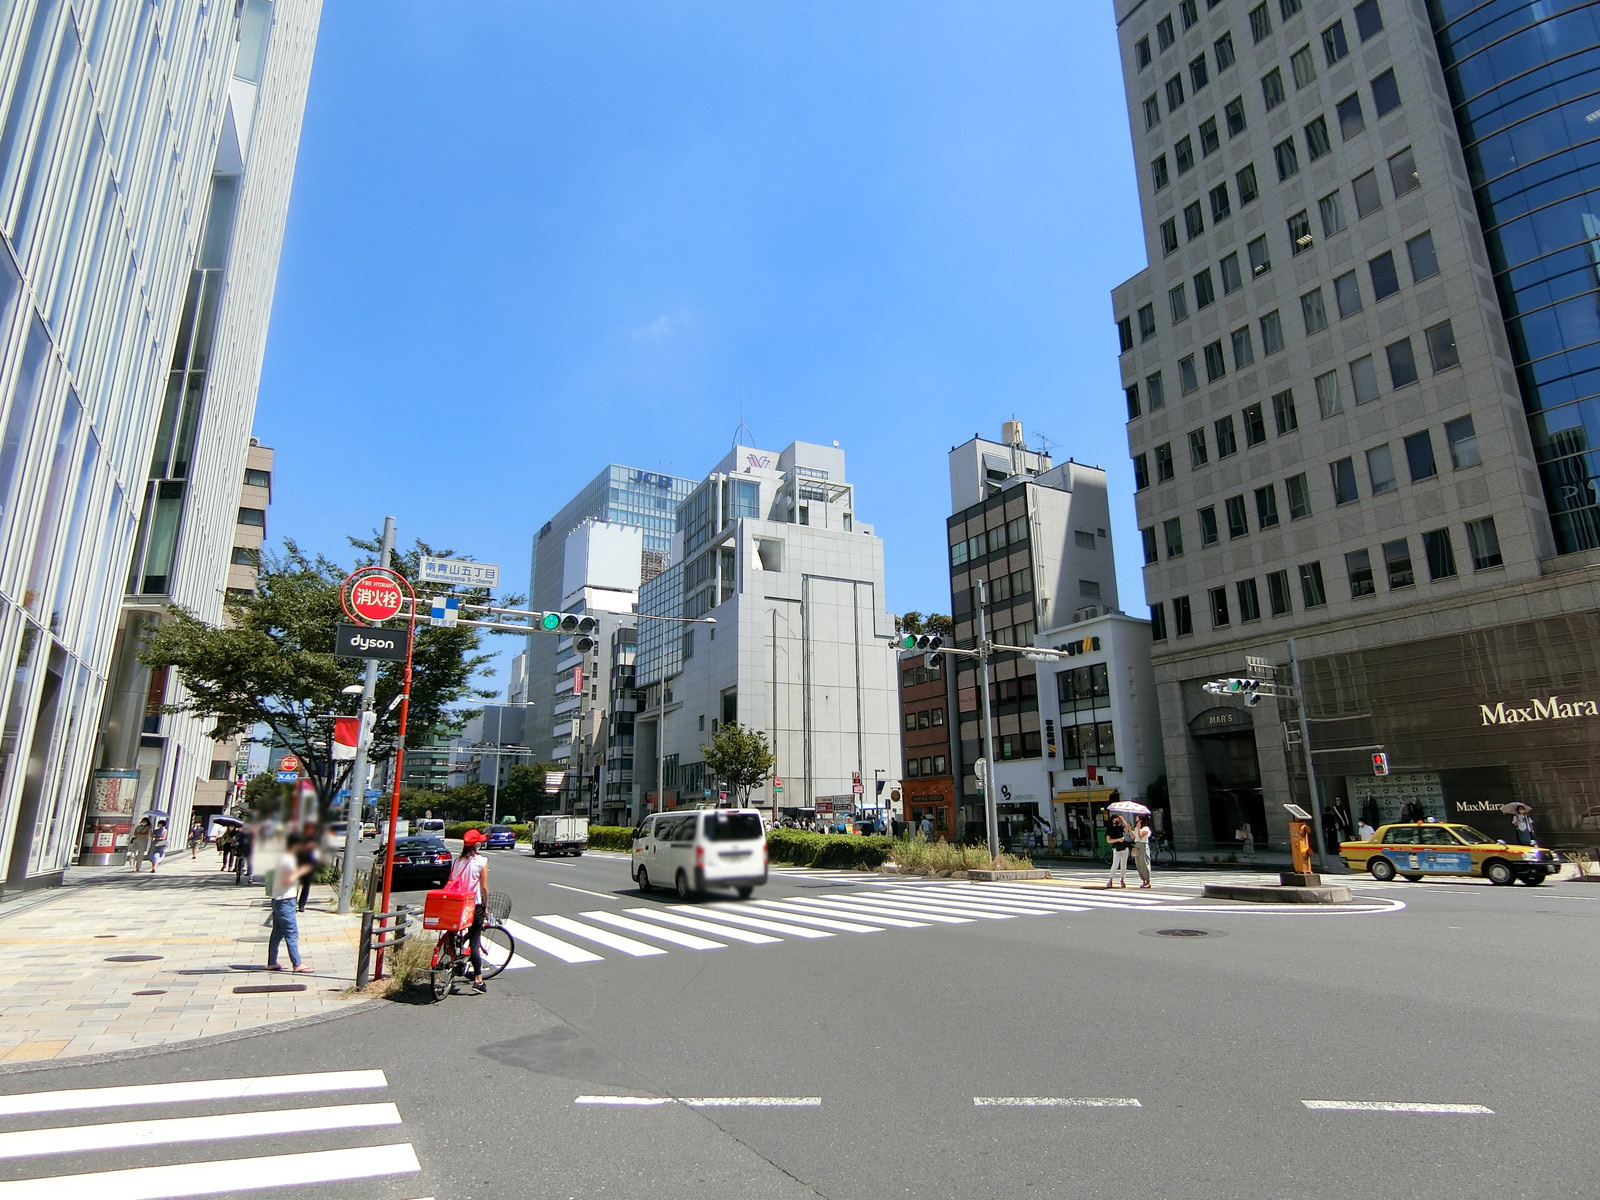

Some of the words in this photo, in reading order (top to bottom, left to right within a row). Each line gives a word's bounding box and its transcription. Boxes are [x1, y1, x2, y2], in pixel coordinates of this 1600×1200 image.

[629, 470, 672, 488] JCB
[425, 562, 495, 579] 南青山五丁目
[356, 587, 398, 608] 消火栓
[350, 634, 394, 651] dyson
[1209, 714, 1232, 725] MAR'S
[1479, 696, 1599, 726] MaxMara
